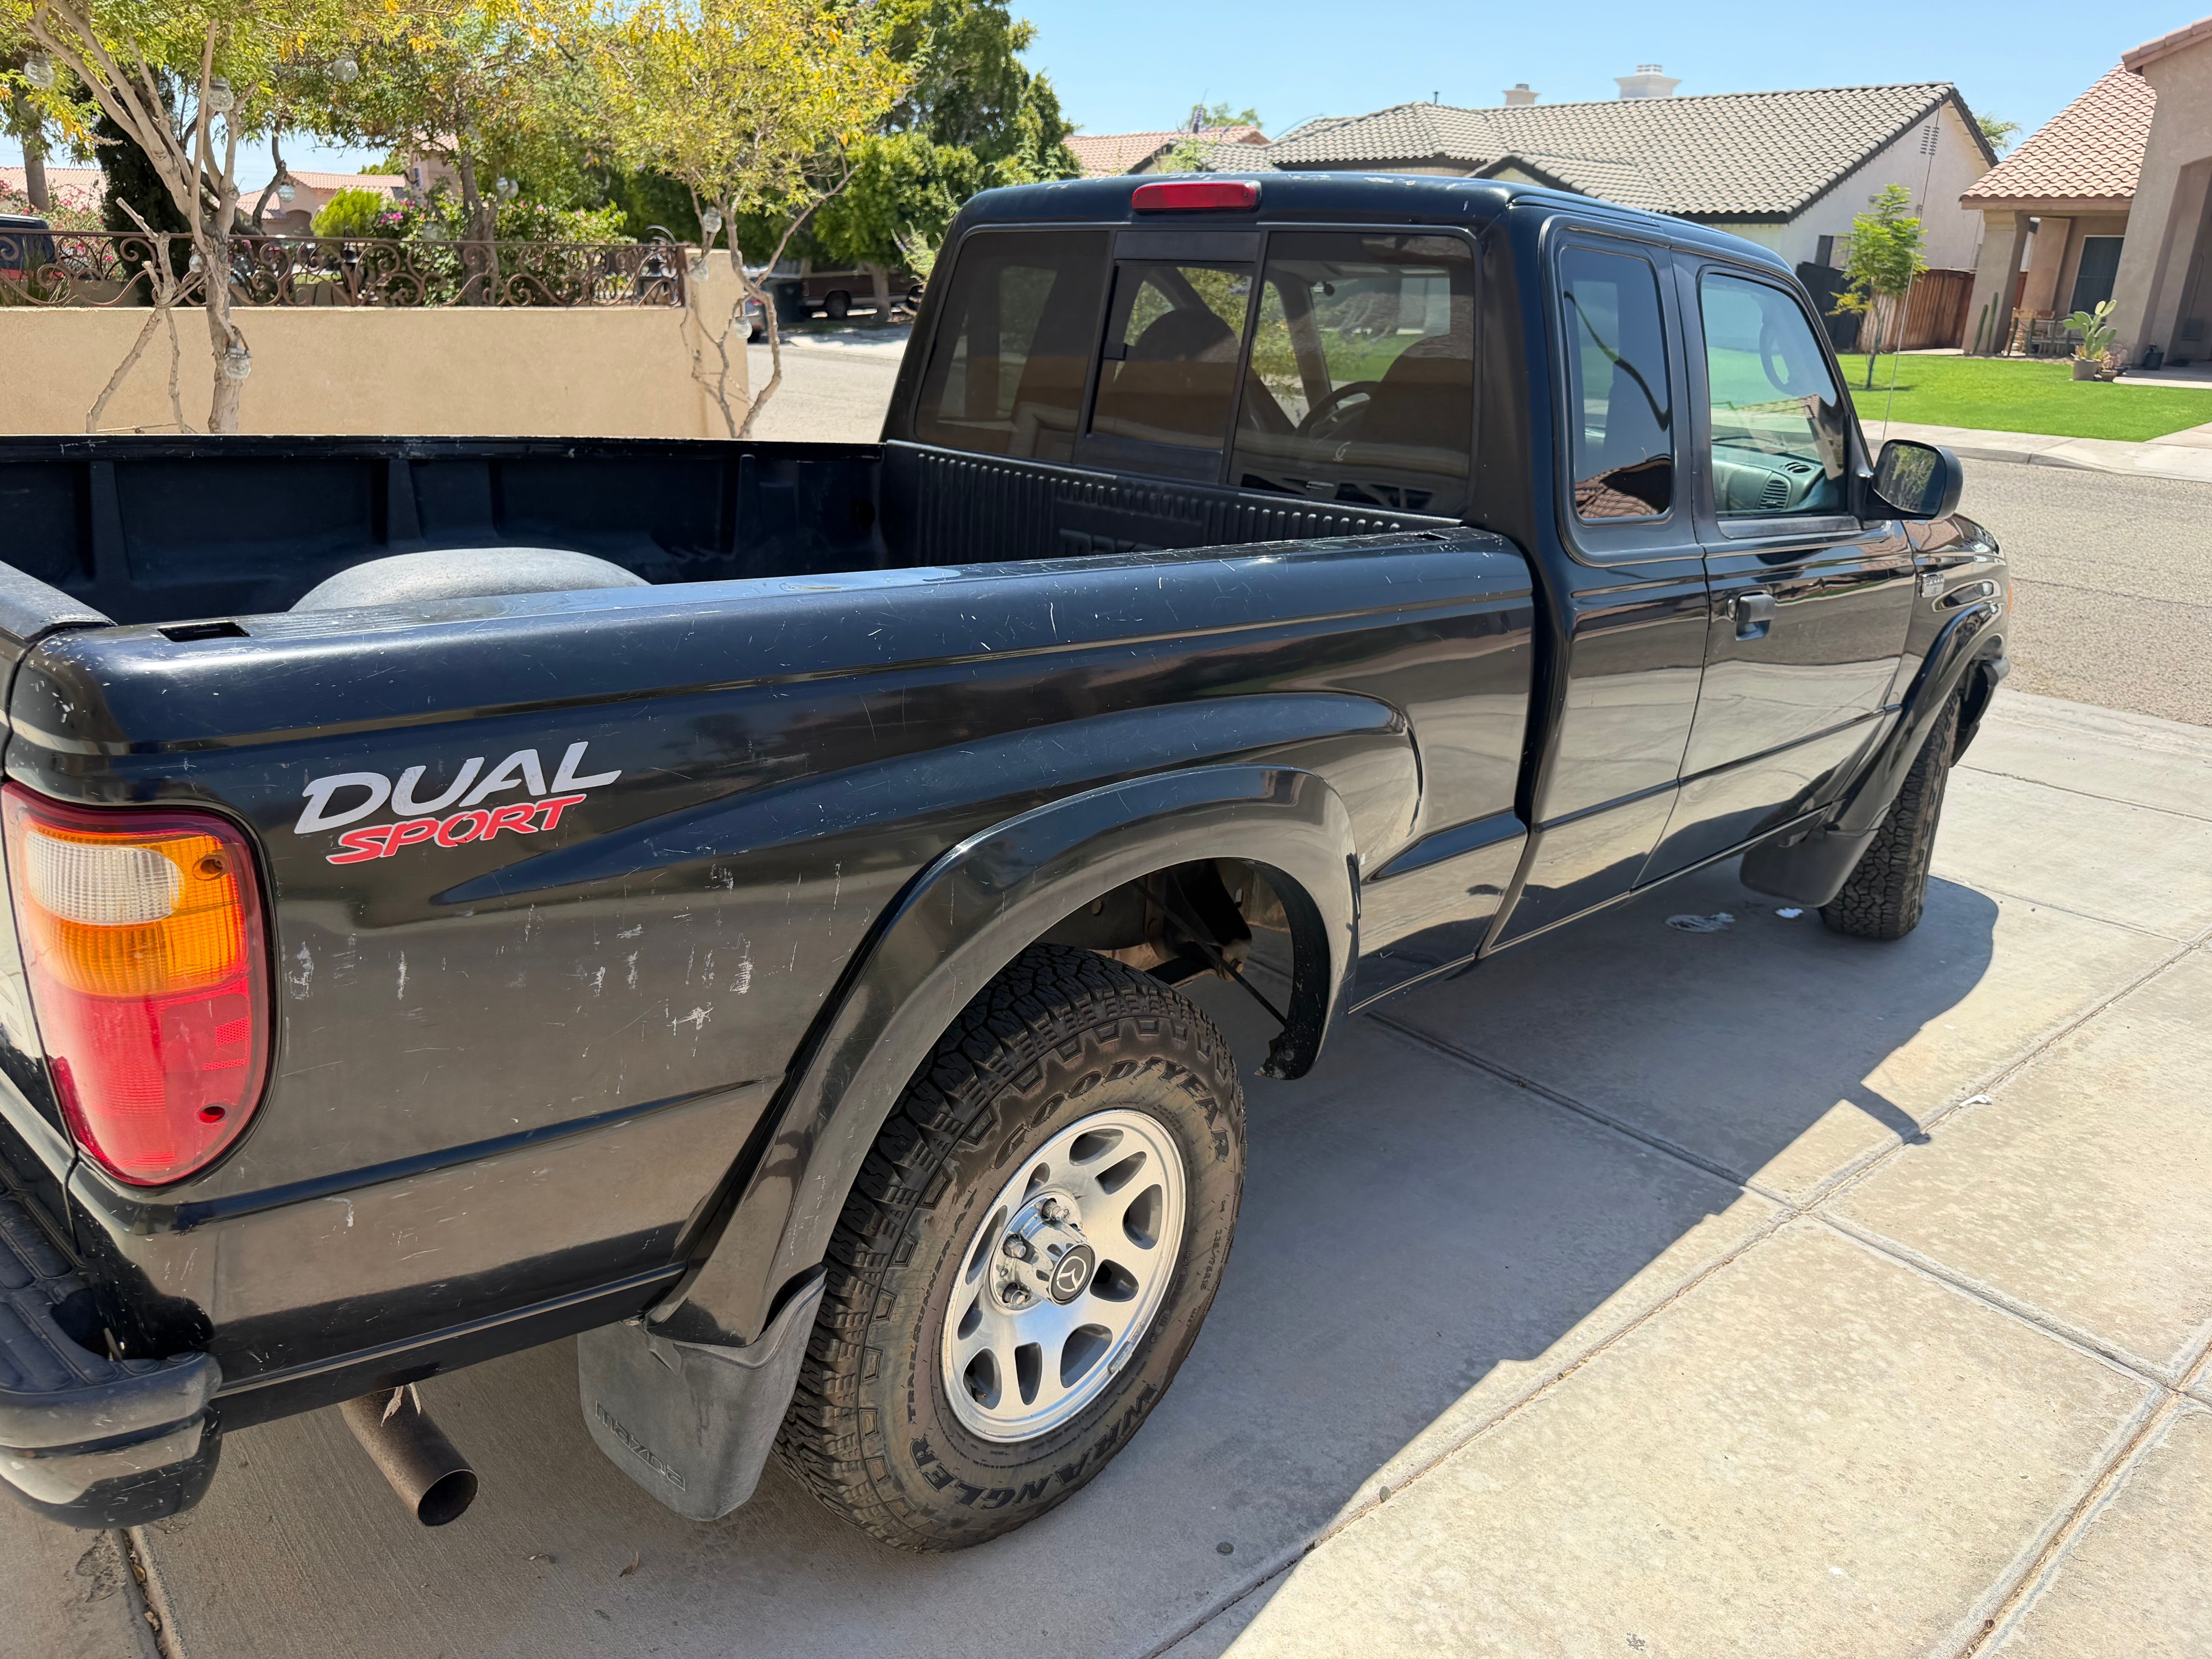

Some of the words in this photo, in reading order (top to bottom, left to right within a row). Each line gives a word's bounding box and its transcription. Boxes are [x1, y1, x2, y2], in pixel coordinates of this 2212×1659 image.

[294, 740, 622, 834] DUAL
[325, 793, 587, 864] SPORT
[993, 1056, 1230, 1170] GOODYEAR
[594, 1400, 686, 1492] mazda
[909, 1383, 1159, 1510] WRANGLER
